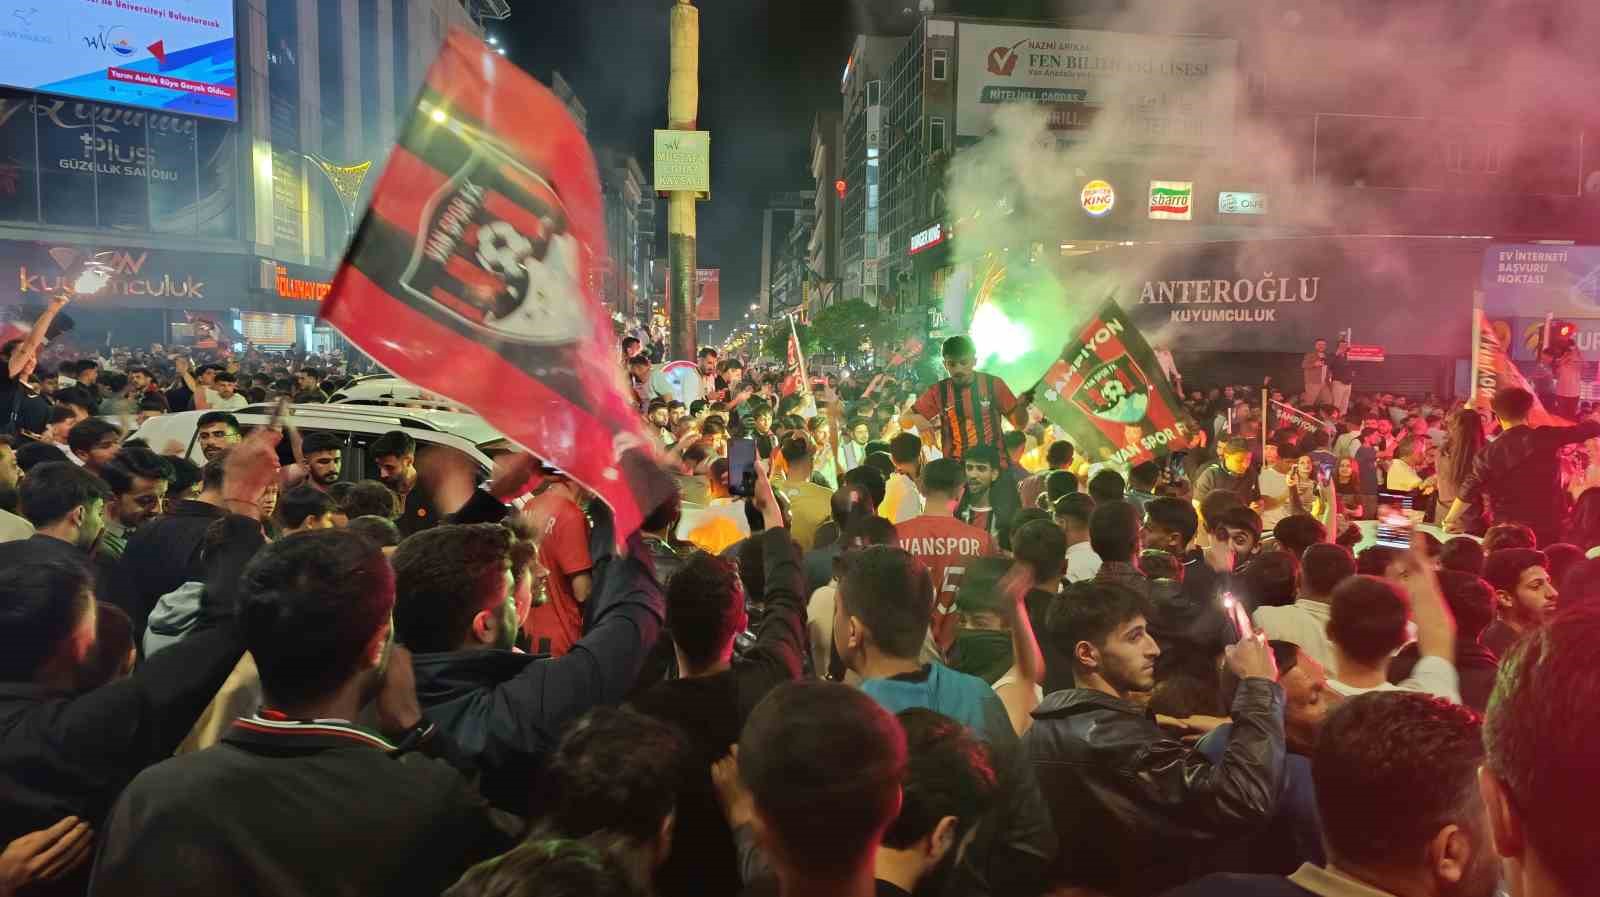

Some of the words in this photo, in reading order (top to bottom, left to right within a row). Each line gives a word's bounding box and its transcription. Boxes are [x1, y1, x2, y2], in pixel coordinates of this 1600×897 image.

[1029, 54, 1062, 68] FEN
[1084, 196, 1112, 206] KING
[1151, 192, 1189, 206] sbarro
[1499, 251, 1514, 262] EV
[1498, 263, 1549, 275] BAŞVURU
[1496, 274, 1545, 285] NOKTASI
[1138, 271, 1320, 304] ANTEROĞLU
[1170, 308, 1276, 322] KUYUMCULUK
[1111, 442, 1142, 464] VAN
[1141, 427, 1176, 450] SPOR
[899, 537, 981, 557] VANSPOR
